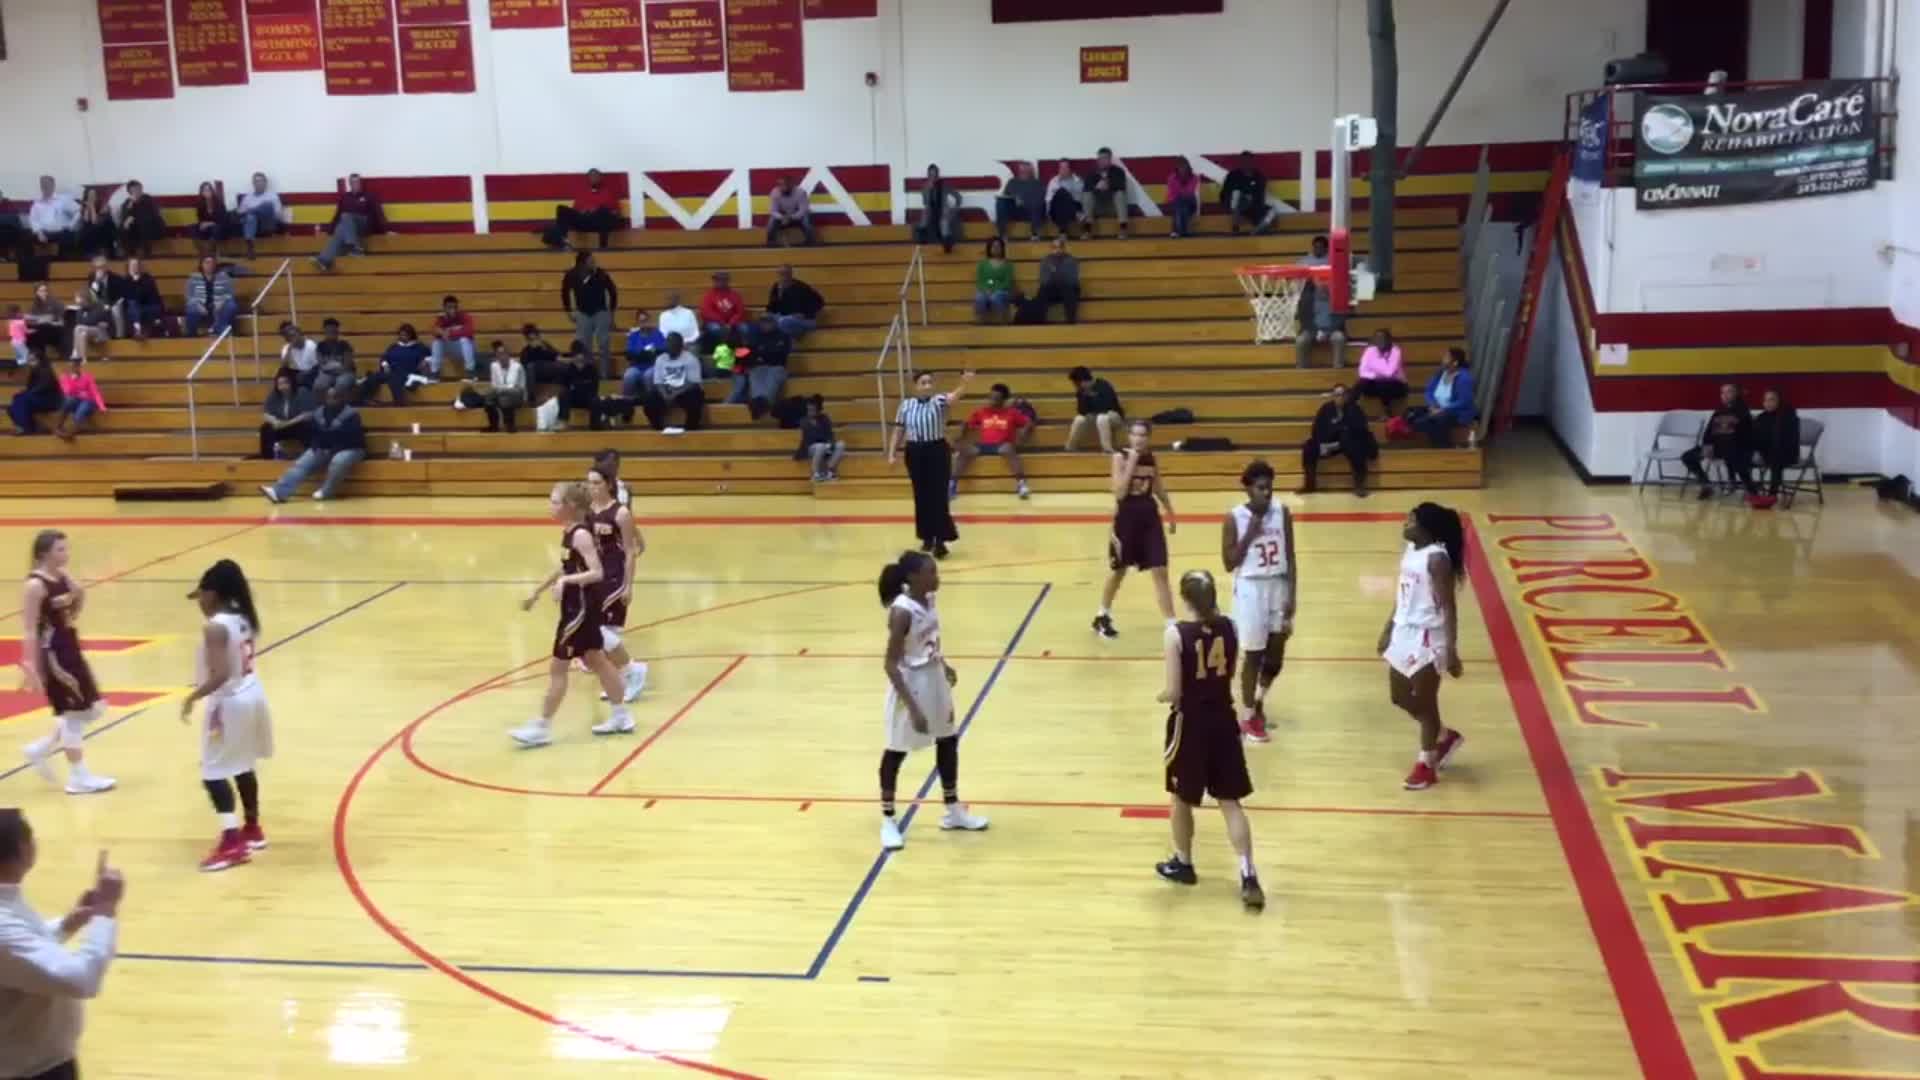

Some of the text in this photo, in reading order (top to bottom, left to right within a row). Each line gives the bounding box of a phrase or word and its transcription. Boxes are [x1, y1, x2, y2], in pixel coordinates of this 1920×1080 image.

[1701, 120, 1864, 151] REHABILITATION
[1254, 541, 1280, 568] 32
[1487, 511, 1769, 730] PURCELL
[1194, 635, 1227, 680] 14
